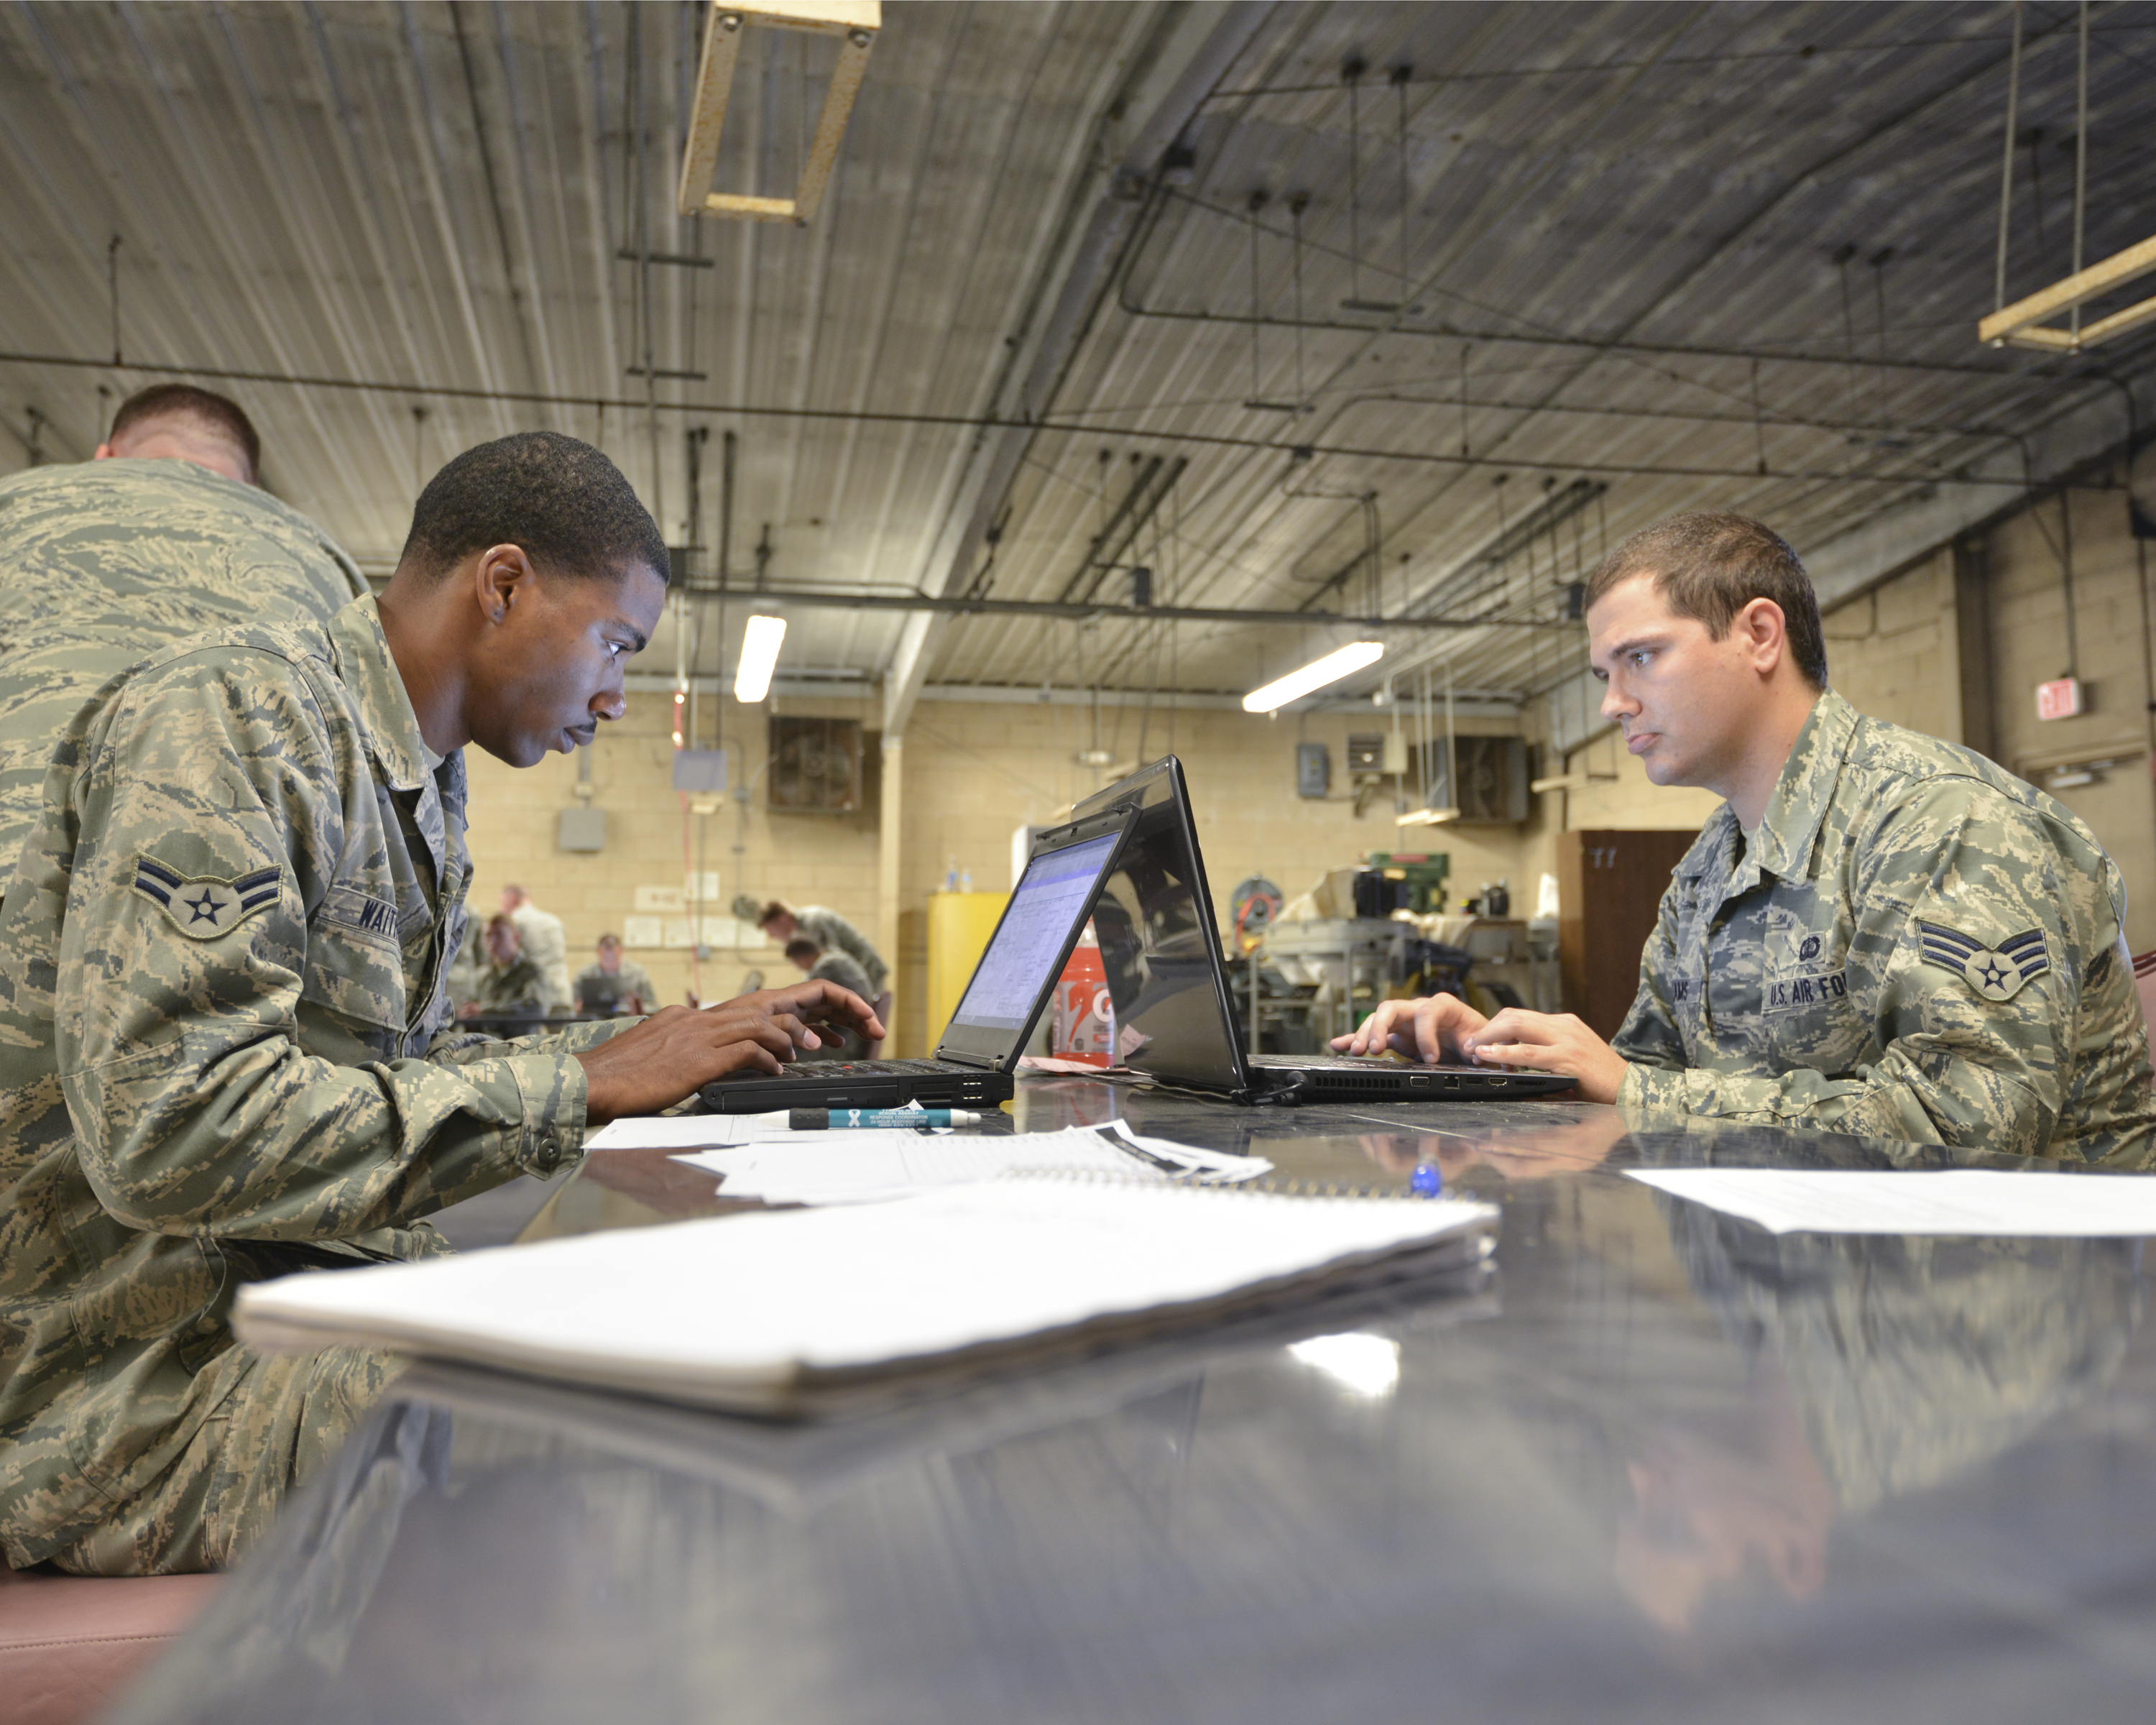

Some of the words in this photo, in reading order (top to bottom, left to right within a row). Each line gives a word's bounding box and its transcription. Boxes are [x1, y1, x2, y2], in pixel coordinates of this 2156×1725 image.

[359, 899, 397, 937] WAIT
[1770, 983, 1787, 1006] U.S.
[1792, 978, 1815, 1003] AIR
